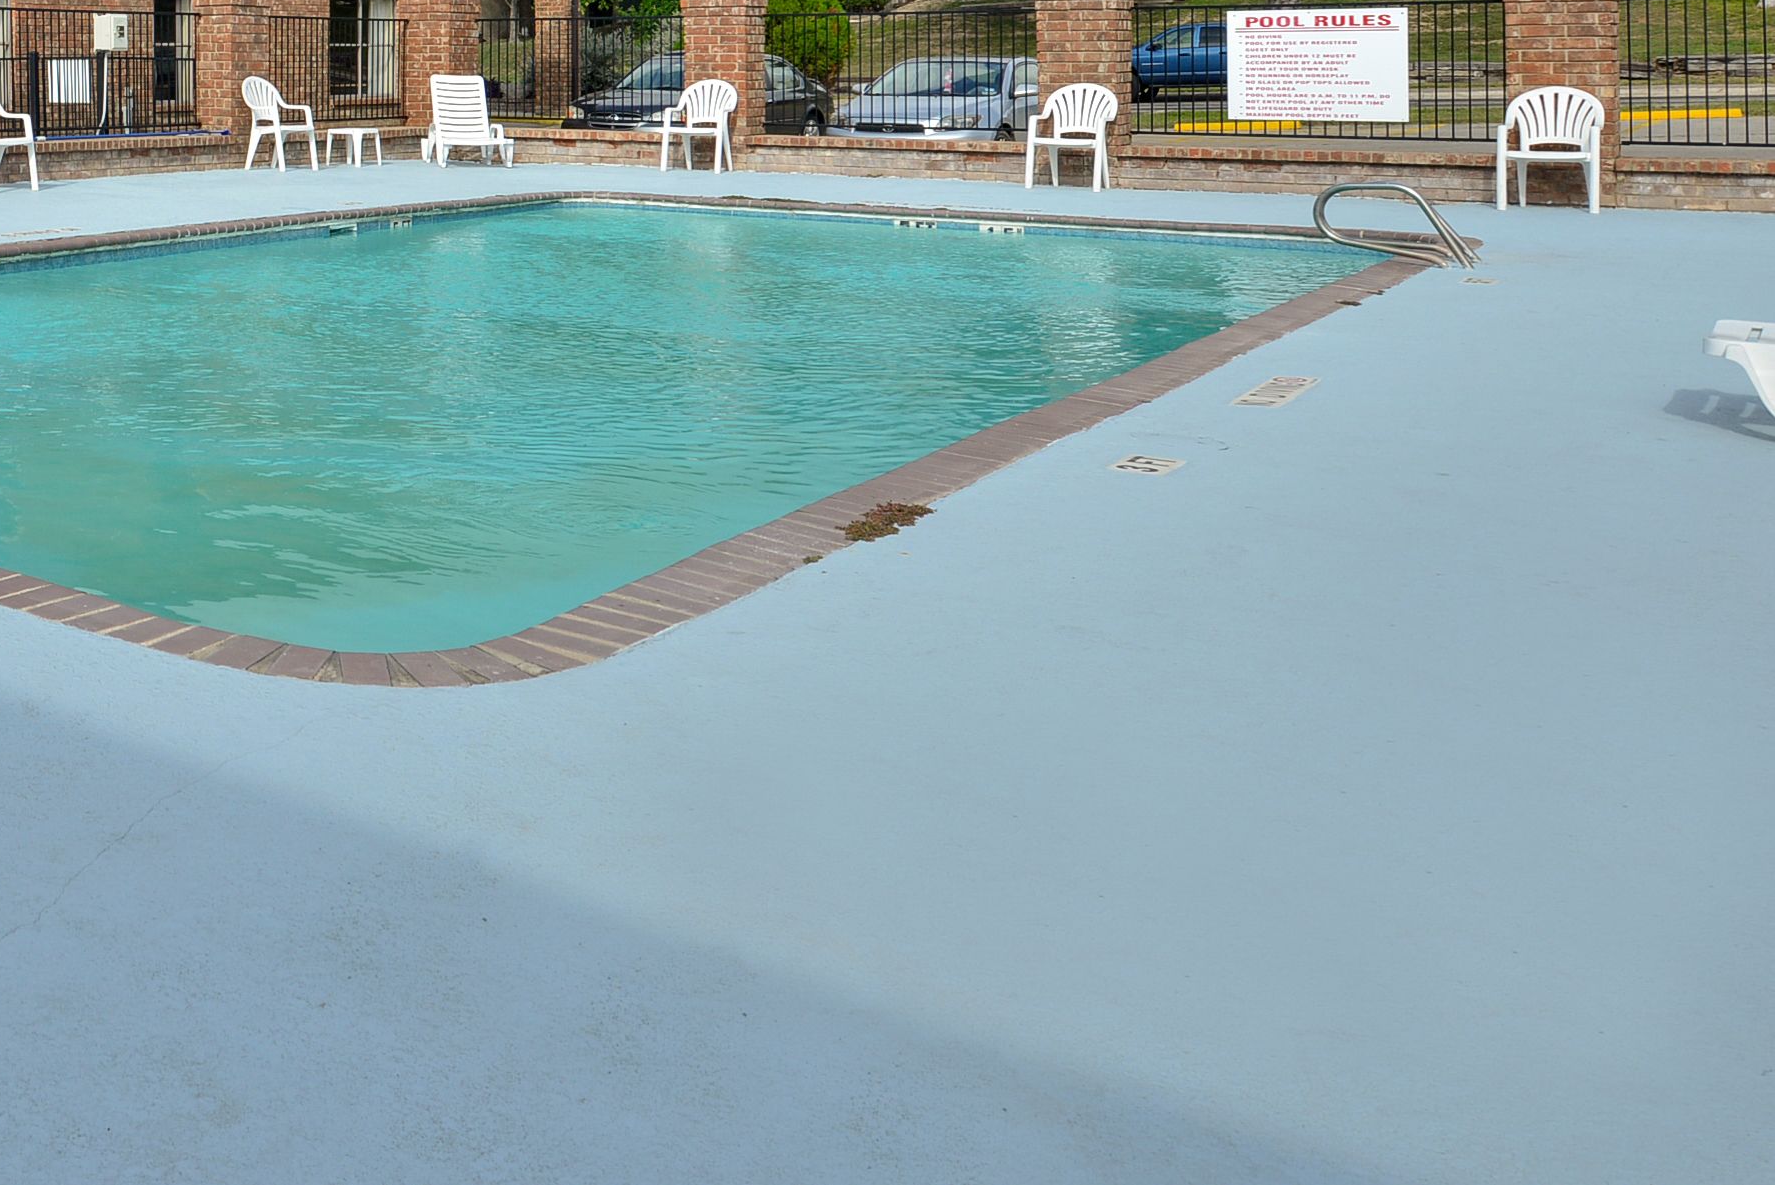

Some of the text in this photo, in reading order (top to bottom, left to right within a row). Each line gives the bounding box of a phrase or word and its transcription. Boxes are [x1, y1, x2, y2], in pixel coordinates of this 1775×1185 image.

[1245, 14, 1392, 28] POOL RULES
[1115, 464, 1159, 473] 3
